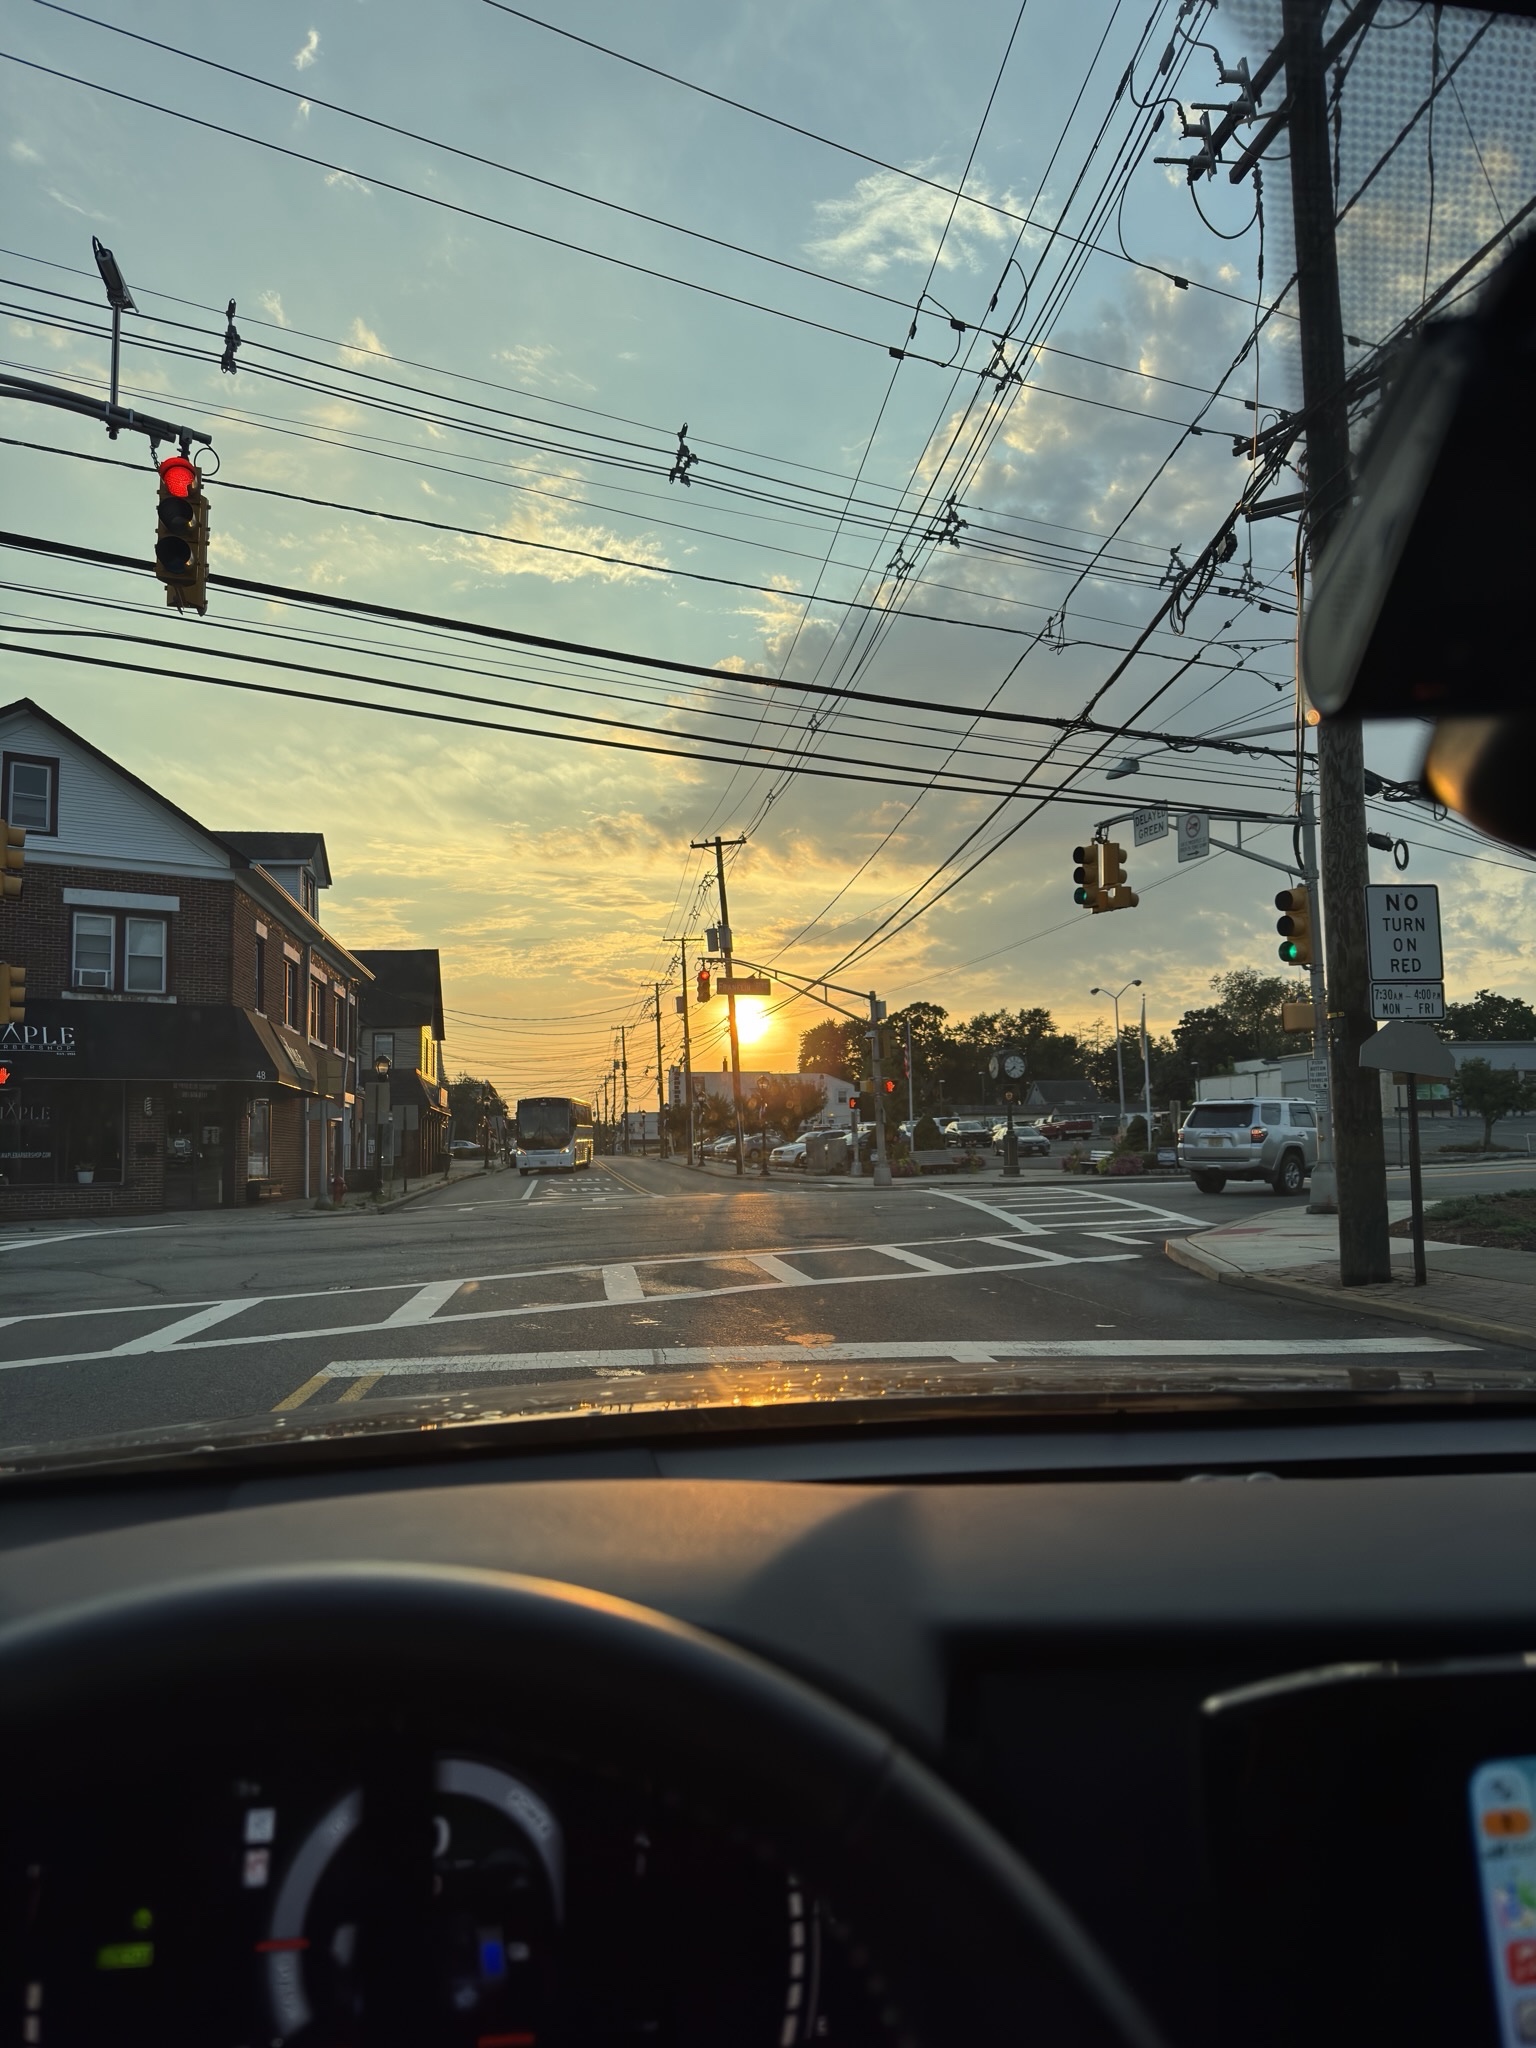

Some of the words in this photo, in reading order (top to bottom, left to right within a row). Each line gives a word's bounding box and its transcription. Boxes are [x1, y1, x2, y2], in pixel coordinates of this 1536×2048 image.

[1135, 810, 1166, 827] DELAYED
[1138, 821, 1164, 839] GREEN
[1386, 894, 1418, 912] NO
[1382, 917, 1425, 932] TURN
[1393, 938, 1417, 952] ON
[1390, 958, 1421, 973] RED
[1382, 1003, 1401, 1014] MON
[1419, 1003, 1434, 1014] FRI
[1, 1022, 75, 1045] APLE
[256, 1070, 266, 1080] 48
